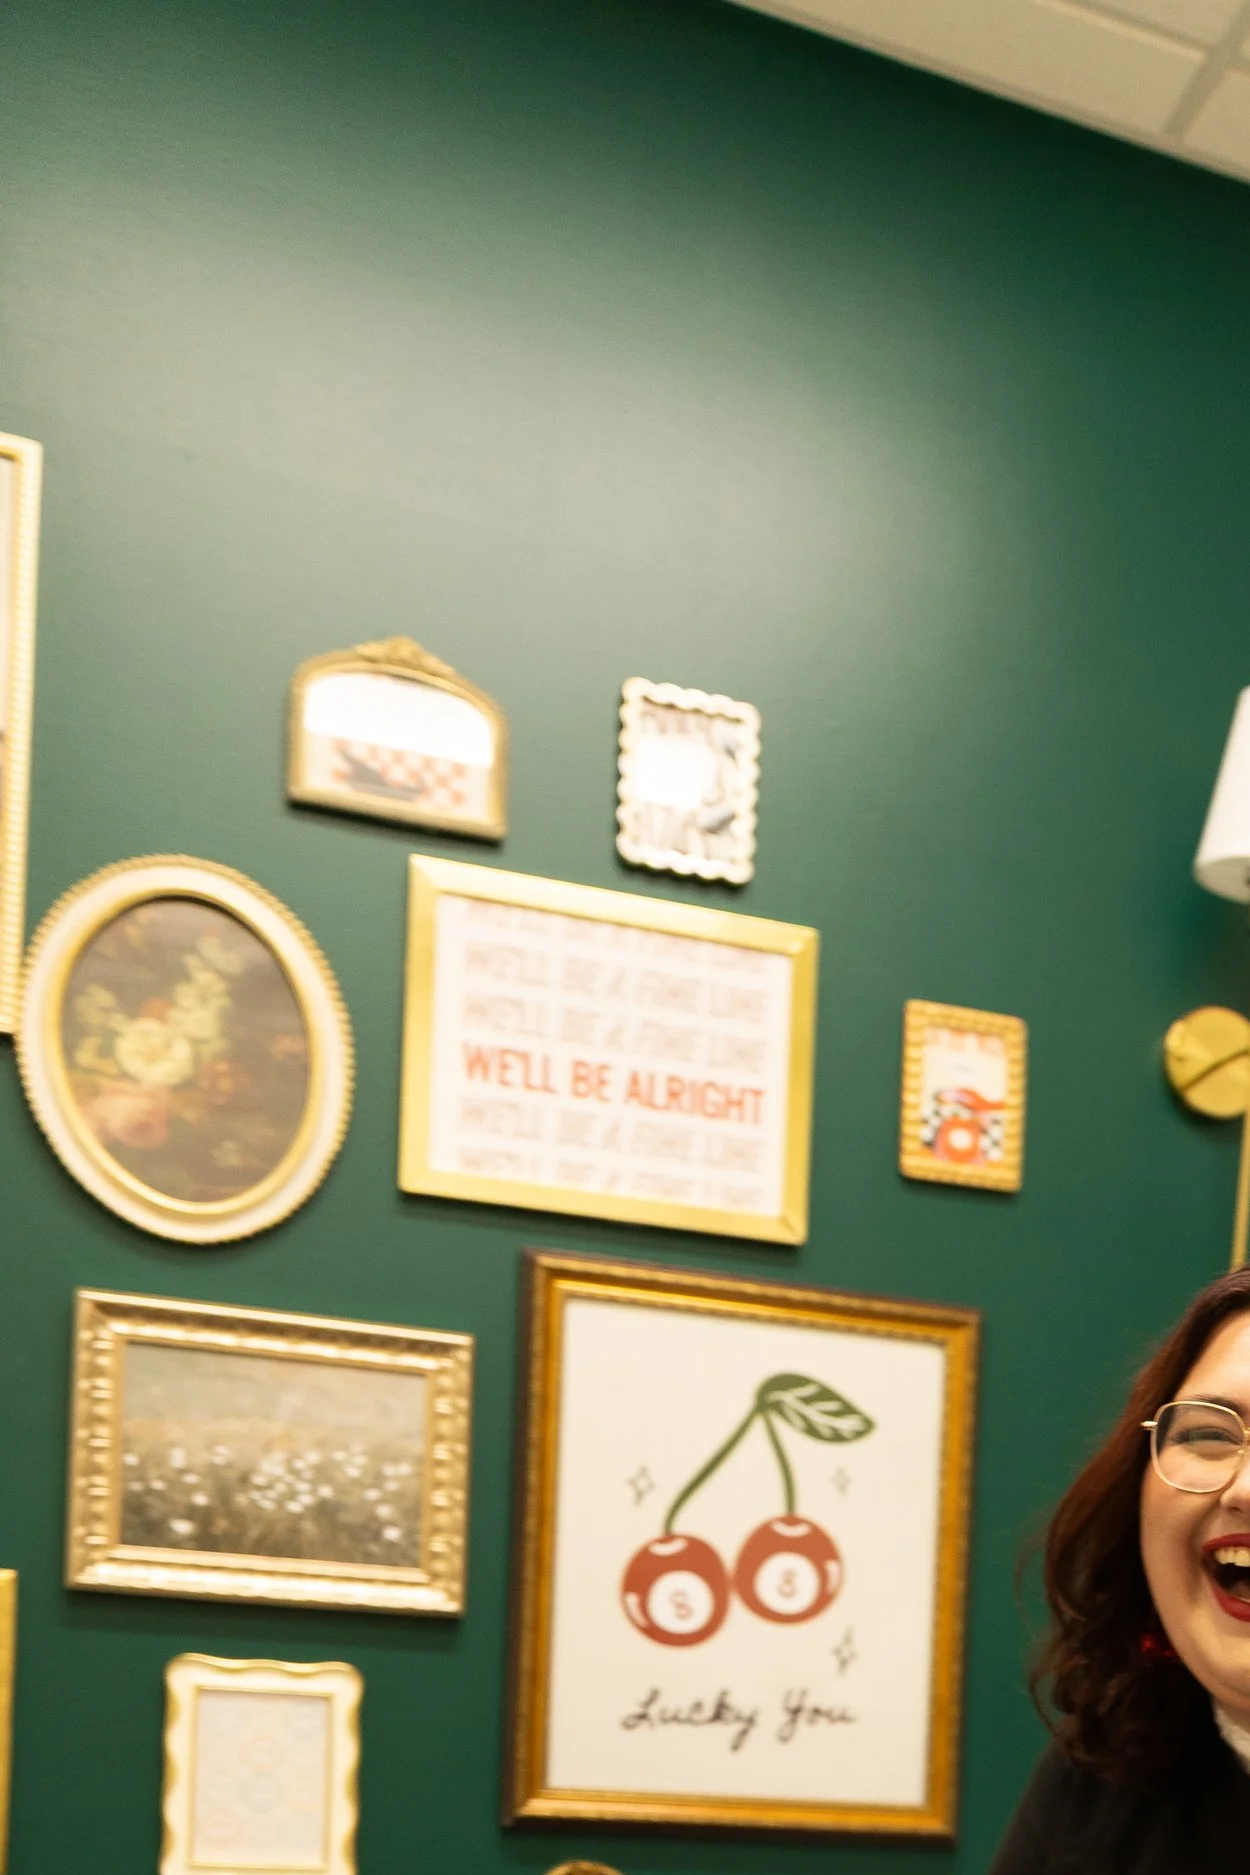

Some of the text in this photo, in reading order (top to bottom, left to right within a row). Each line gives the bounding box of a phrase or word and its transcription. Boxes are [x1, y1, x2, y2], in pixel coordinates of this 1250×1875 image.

[461, 1042, 767, 1126] WE'LL BE ALRIGHT
[620, 1687, 857, 1753] Lucky You
